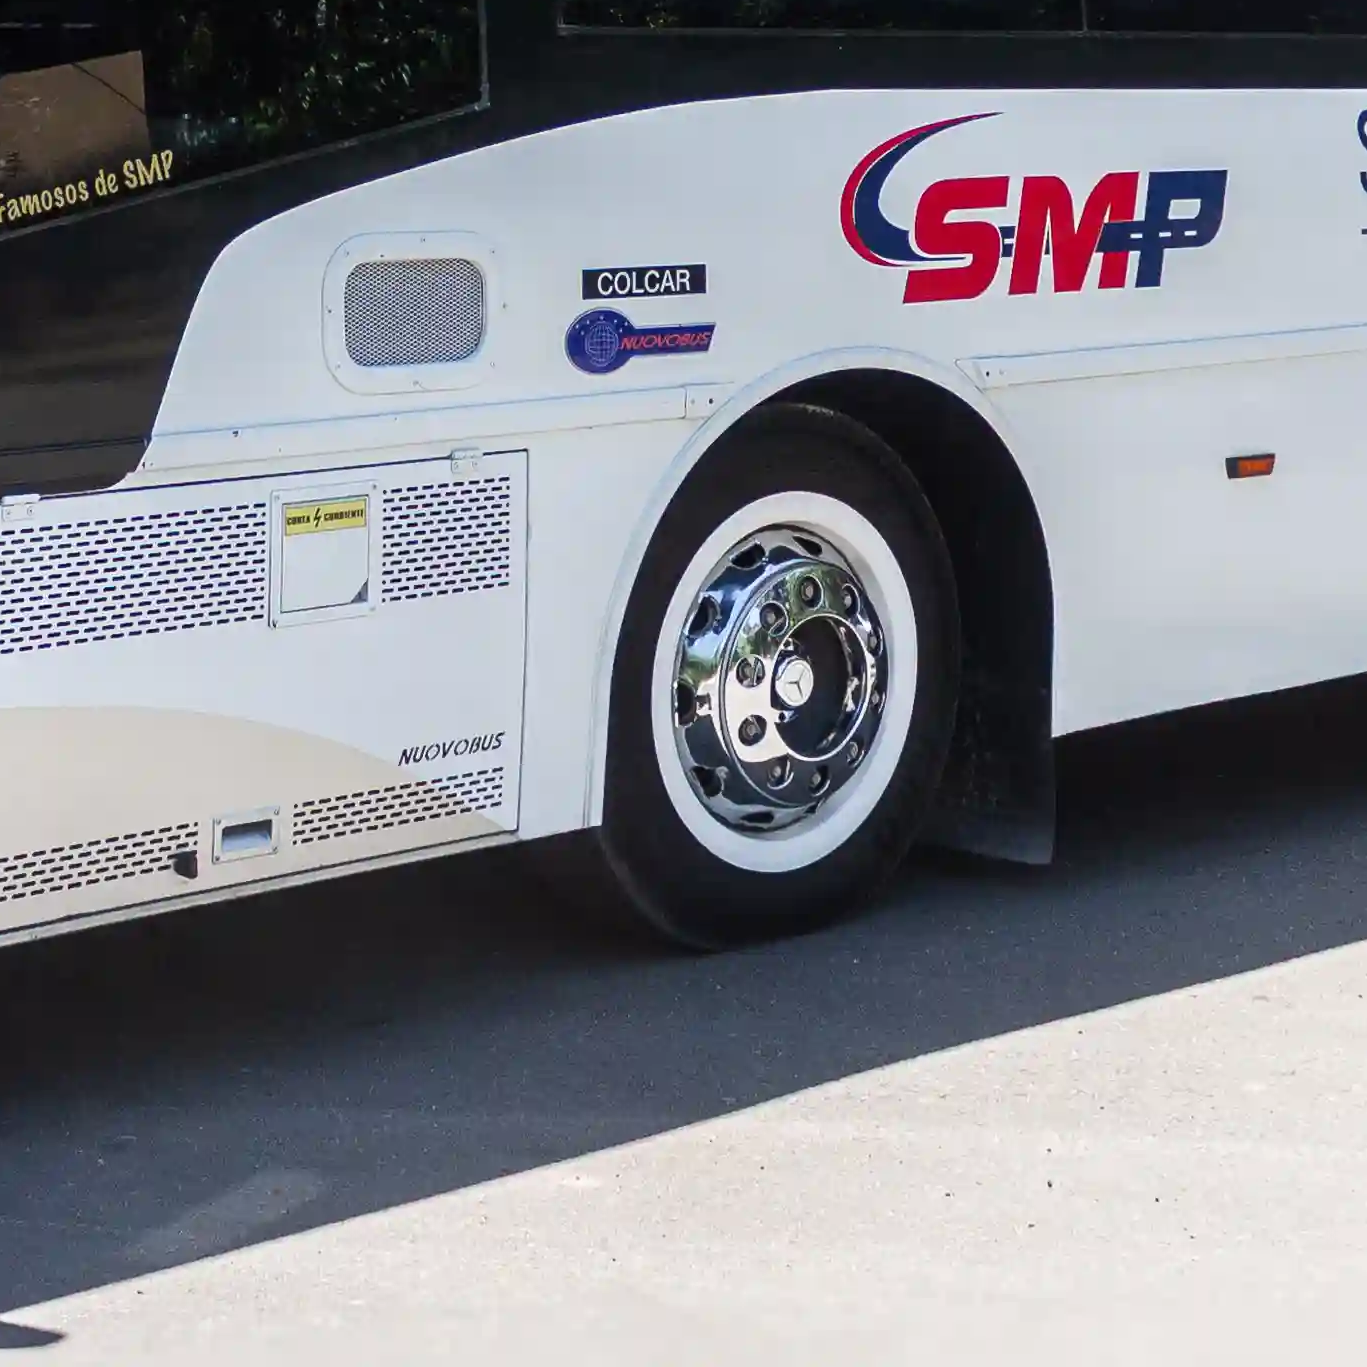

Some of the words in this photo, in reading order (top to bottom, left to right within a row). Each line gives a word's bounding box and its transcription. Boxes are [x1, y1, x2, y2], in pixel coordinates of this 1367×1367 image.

[95, 169, 119, 196] de
[122, 149, 174, 190] SMP
[902, 169, 1229, 304] SMP
[597, 269, 691, 296] COLCAR
[620, 332, 711, 351] NUOVOBUS
[398, 730, 505, 766] NUOVOBUS
